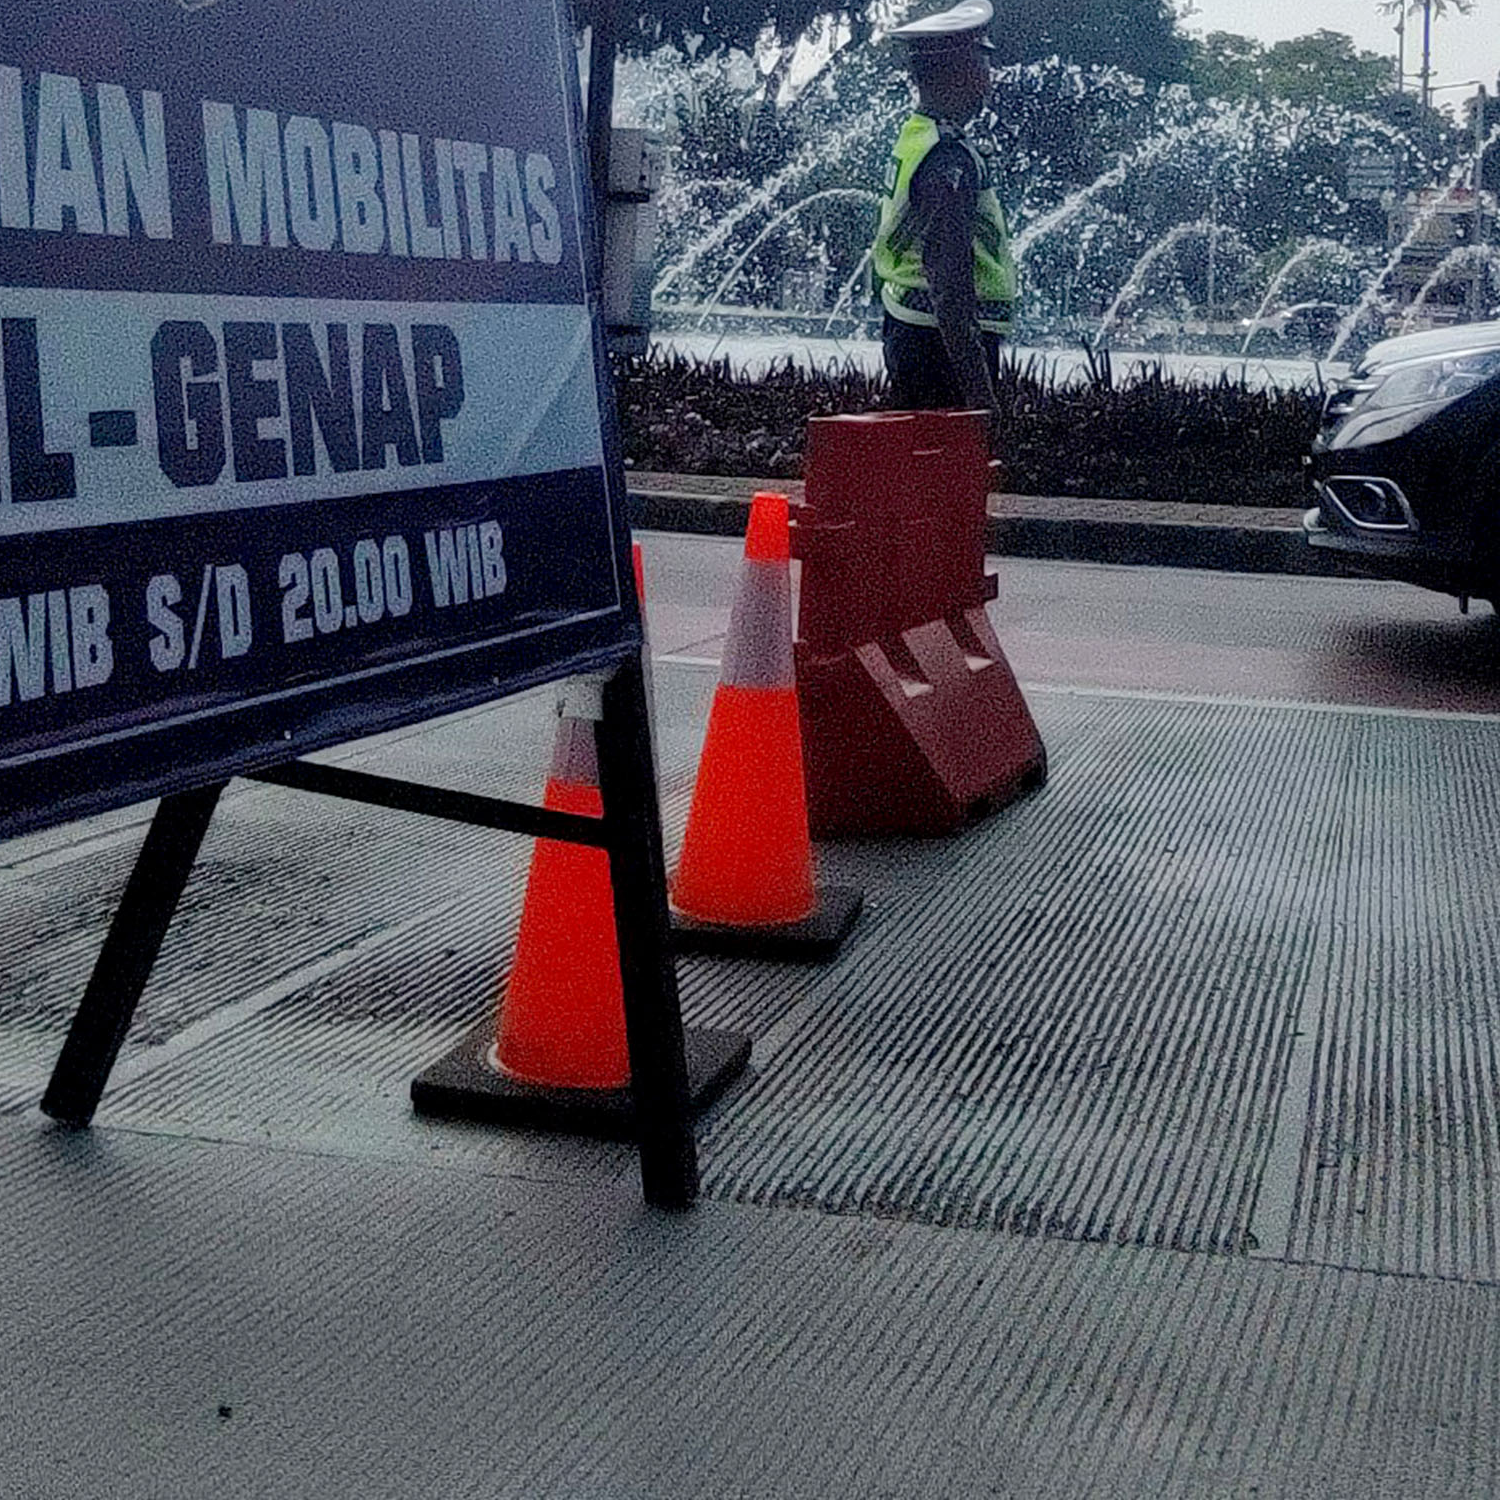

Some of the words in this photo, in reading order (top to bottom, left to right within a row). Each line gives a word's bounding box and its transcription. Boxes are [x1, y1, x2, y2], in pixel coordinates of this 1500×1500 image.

[202, 101, 563, 264] MOBILITAS
[146, 562, 252, 672] S/D
[277, 535, 412, 644] 20.00
[424, 519, 508, 607] WIB
